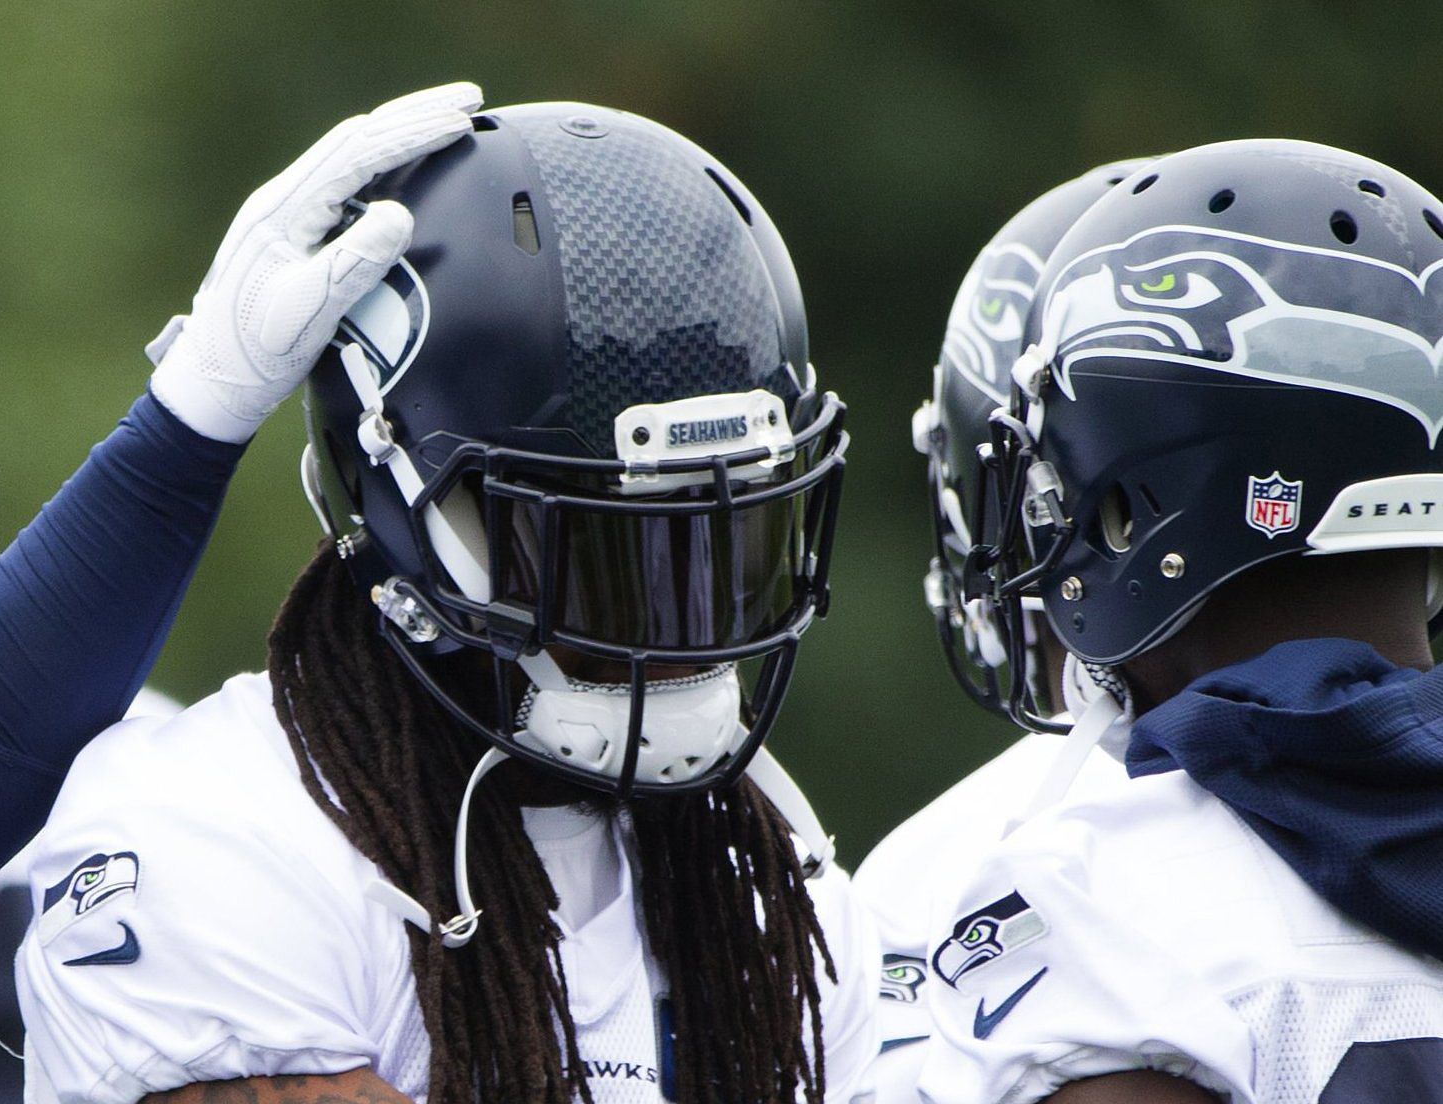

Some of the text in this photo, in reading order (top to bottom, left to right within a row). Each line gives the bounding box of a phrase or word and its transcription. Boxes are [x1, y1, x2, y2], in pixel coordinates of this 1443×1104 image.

[669, 415, 747, 445] SEAHAWKS
[1255, 500, 1292, 528] NFL
[1347, 501, 1436, 519] SEAT
